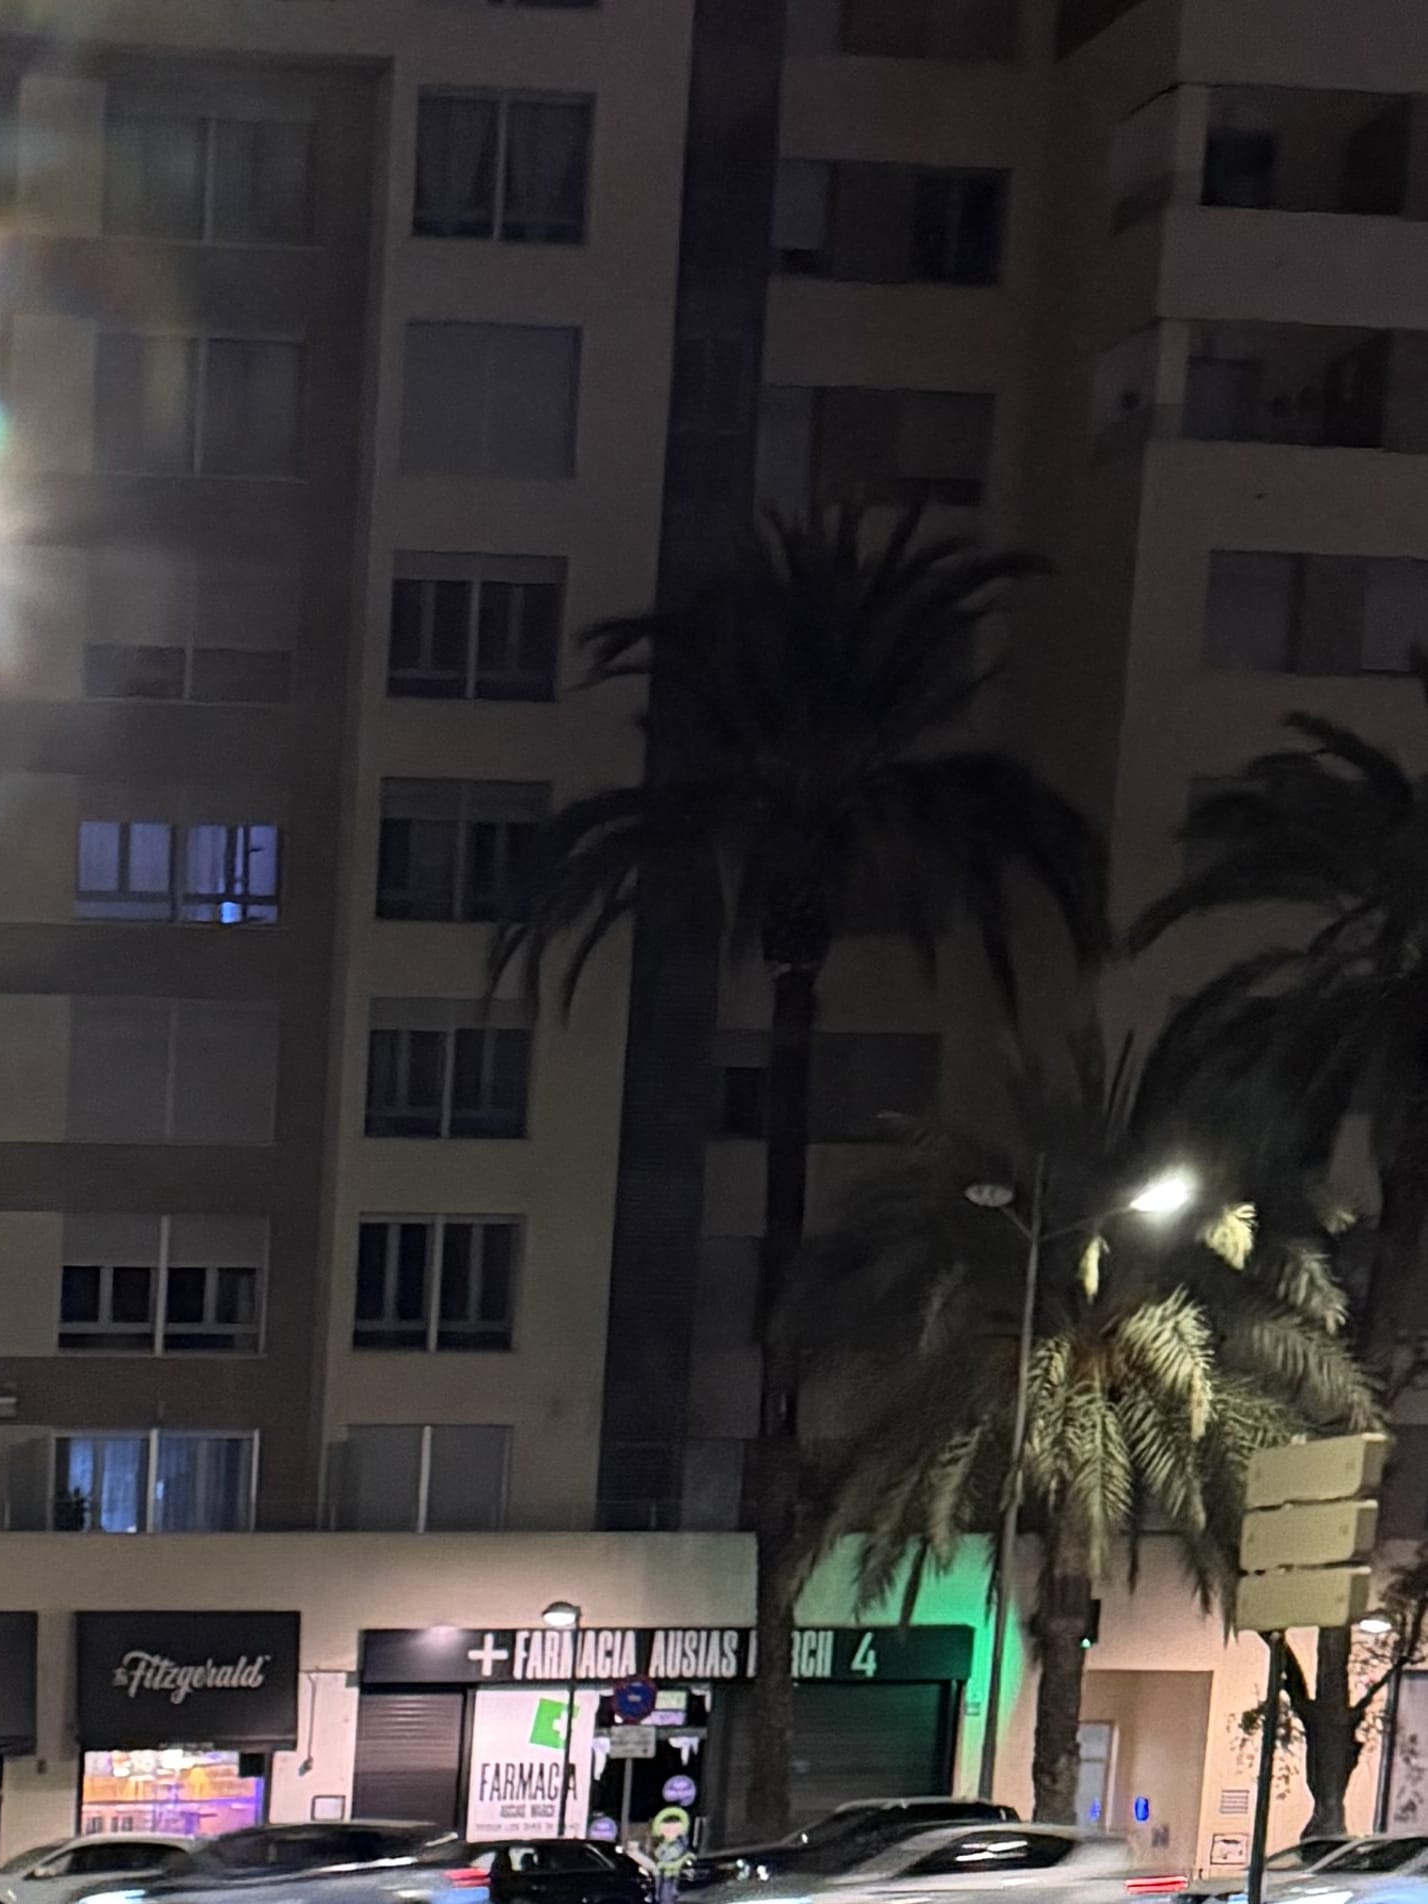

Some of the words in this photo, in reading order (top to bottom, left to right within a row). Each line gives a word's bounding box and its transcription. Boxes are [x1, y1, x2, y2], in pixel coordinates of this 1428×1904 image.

[121, 1650, 265, 1704] Fitzgerald
[513, 1630, 636, 1679] FARMACIA
[649, 1629, 738, 1678] AUSIAS
[851, 1632, 876, 1678] 4
[479, 1762, 578, 1802] FARMACA
